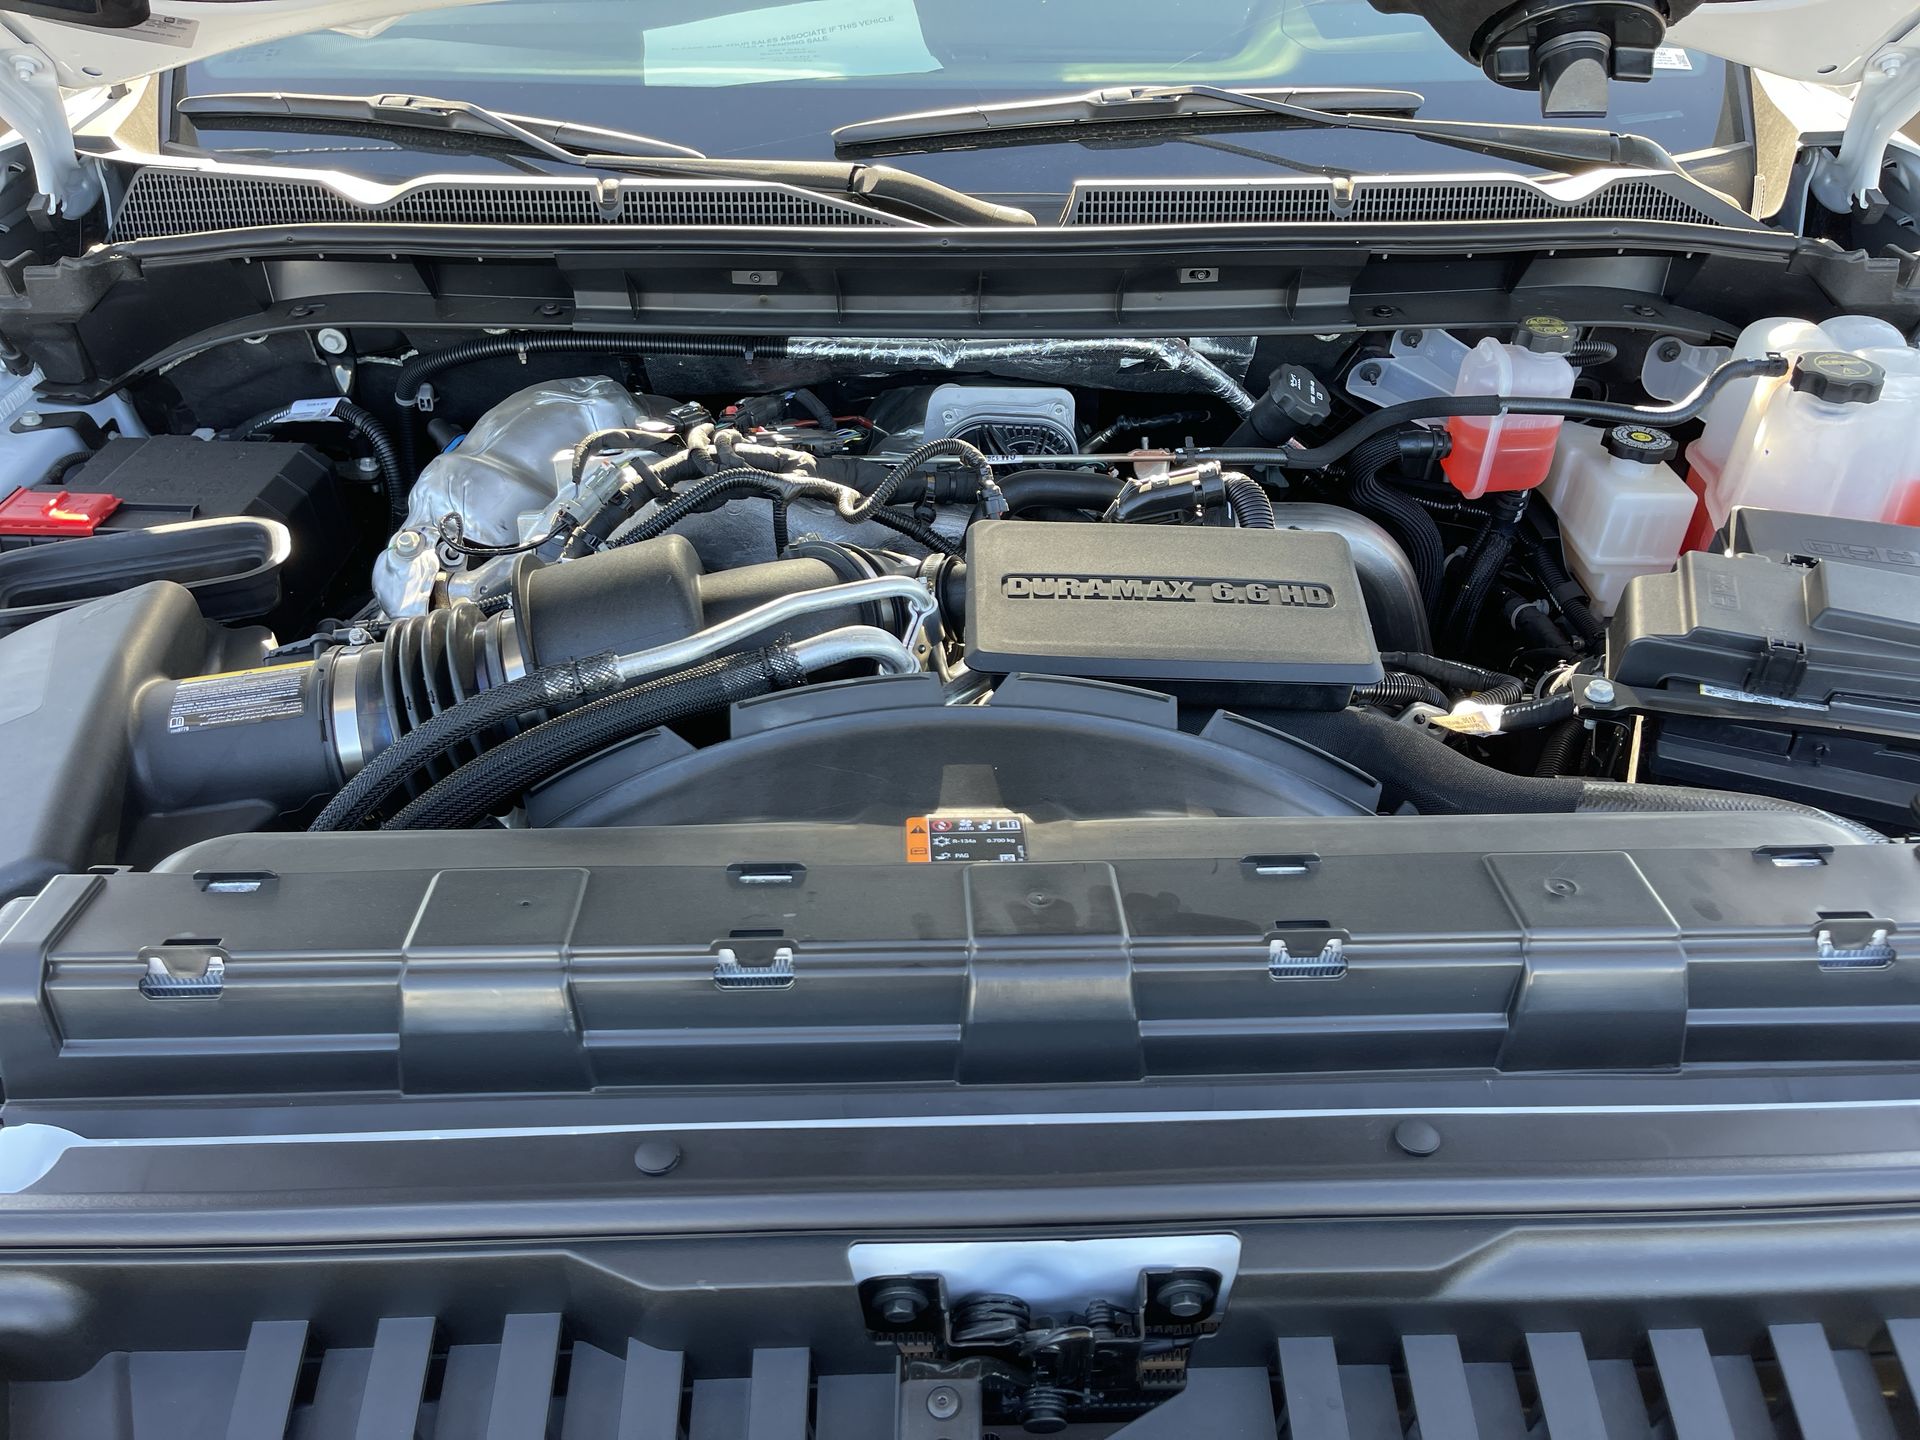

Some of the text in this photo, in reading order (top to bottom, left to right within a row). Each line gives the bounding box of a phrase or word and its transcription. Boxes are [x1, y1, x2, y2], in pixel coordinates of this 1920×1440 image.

[752, 37, 778, 46] SALES
[781, 27, 827, 42] ASSOCIATE
[829, 25, 838, 33] IF
[839, 23, 857, 32] THIS
[860, 15, 895, 27] VEHICLE
[1006, 577, 1331, 607] DURAMAX 6.6 HD
